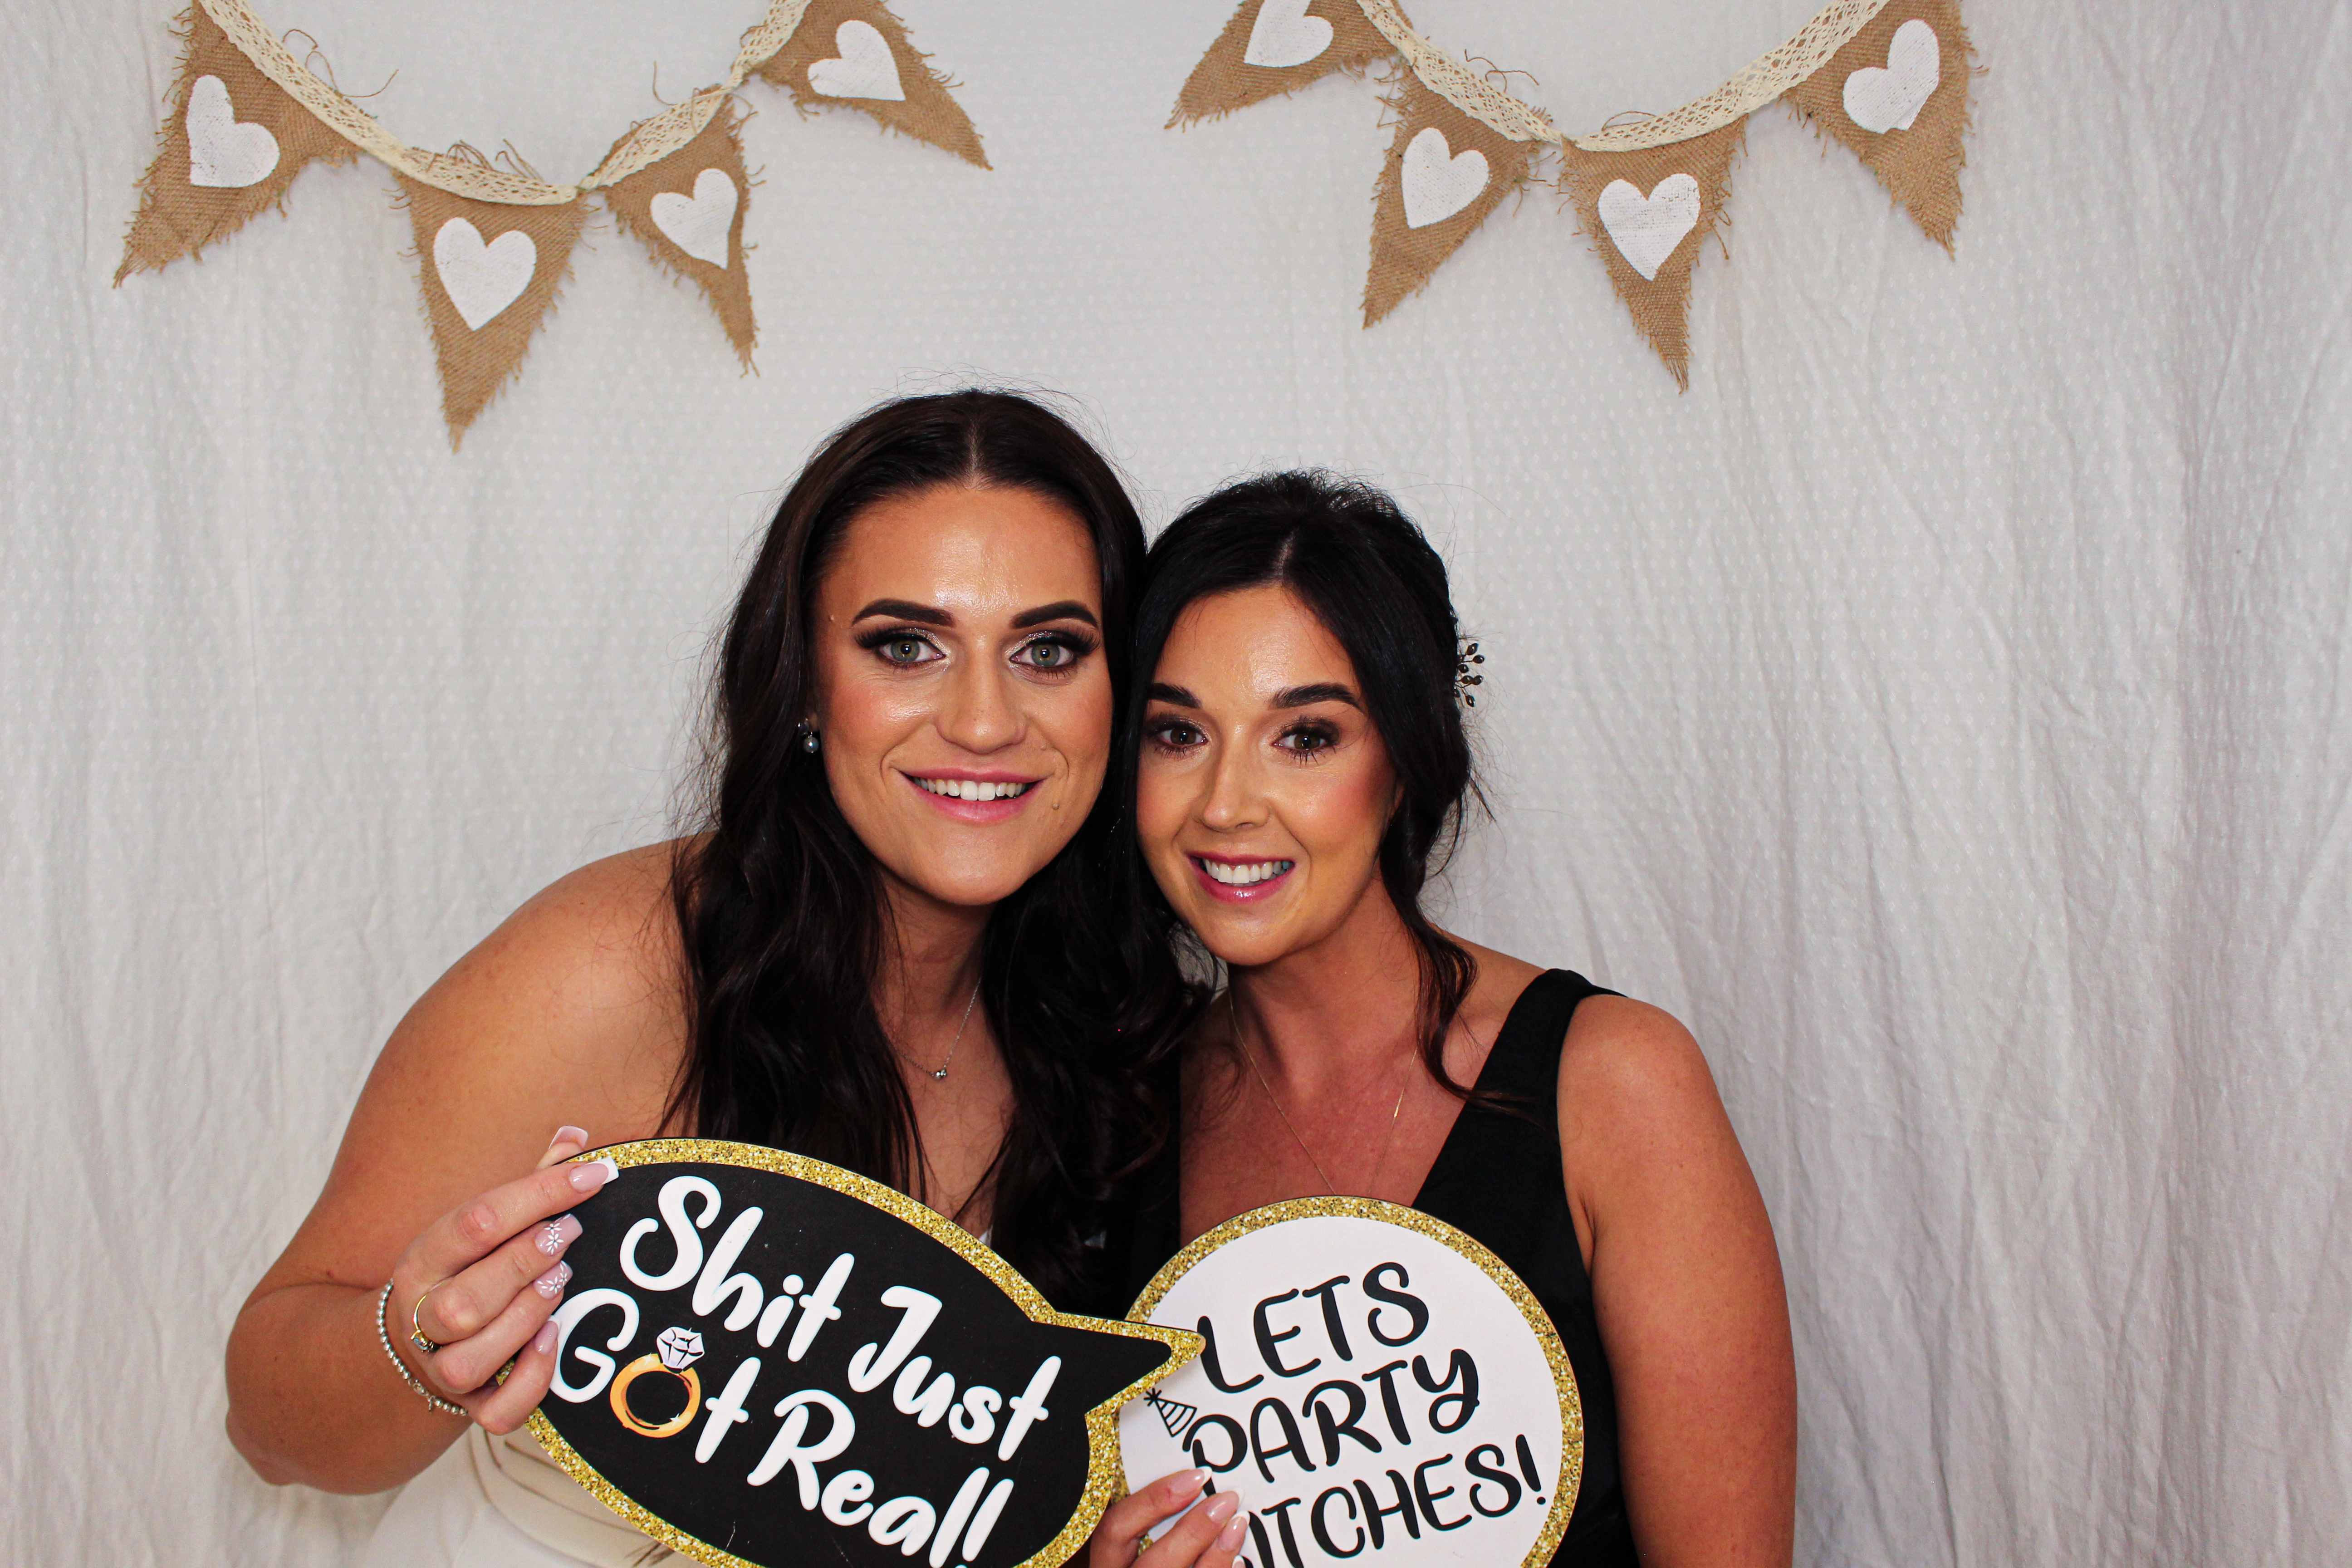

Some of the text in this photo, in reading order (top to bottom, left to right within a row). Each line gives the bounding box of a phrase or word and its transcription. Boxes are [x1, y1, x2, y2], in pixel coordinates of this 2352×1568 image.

[620, 1176, 1061, 1461] Shit Just
[1197, 1262, 1429, 1393] LETS
[747, 1389, 1014, 1568] Real!
[1182, 1349, 1480, 1496] PARTY
[1242, 1434, 1546, 1568] ITCHES!
